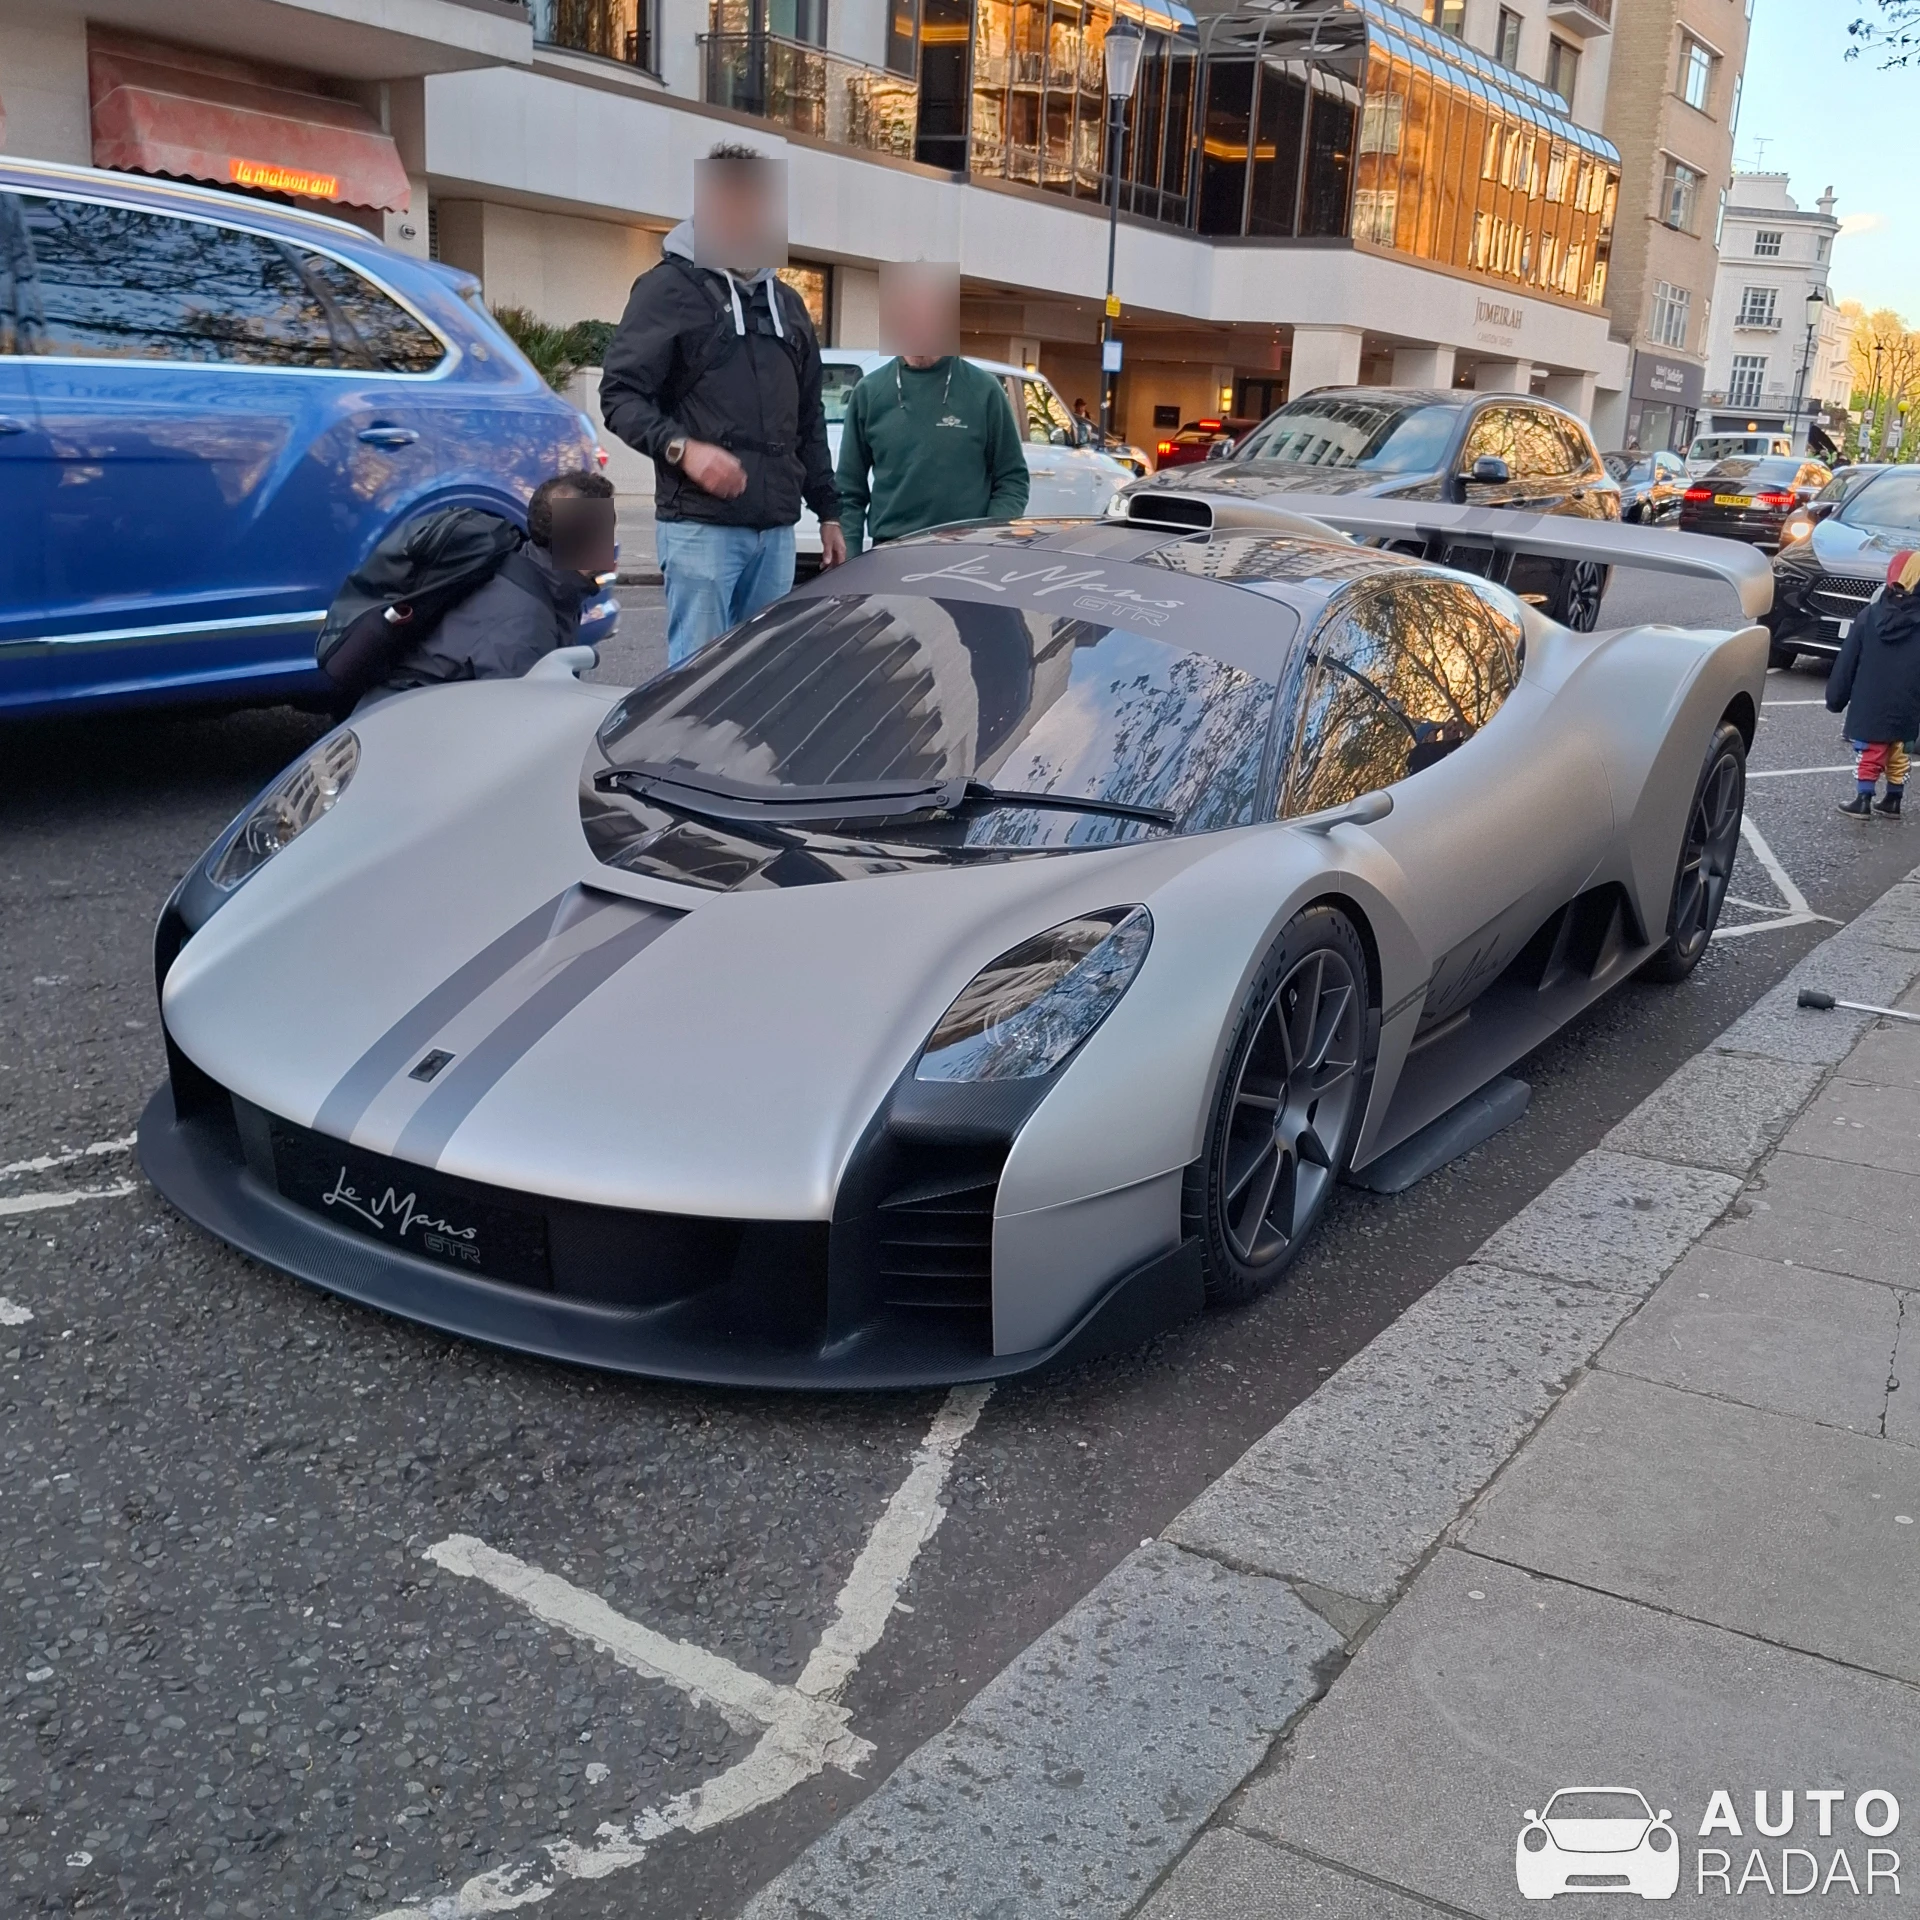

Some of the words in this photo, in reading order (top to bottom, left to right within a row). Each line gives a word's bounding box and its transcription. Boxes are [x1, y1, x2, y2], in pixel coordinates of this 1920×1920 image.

[253, 168, 309, 191] maison
[1473, 296, 1523, 330] JUMEIRAH
[901, 554, 1006, 592] Le
[1001, 565, 1185, 609] Mans
[1073, 595, 1170, 627] GTR
[322, 1166, 385, 1229] Le
[371, 1187, 477, 1239] Mans
[424, 1232, 481, 1264] GTR
